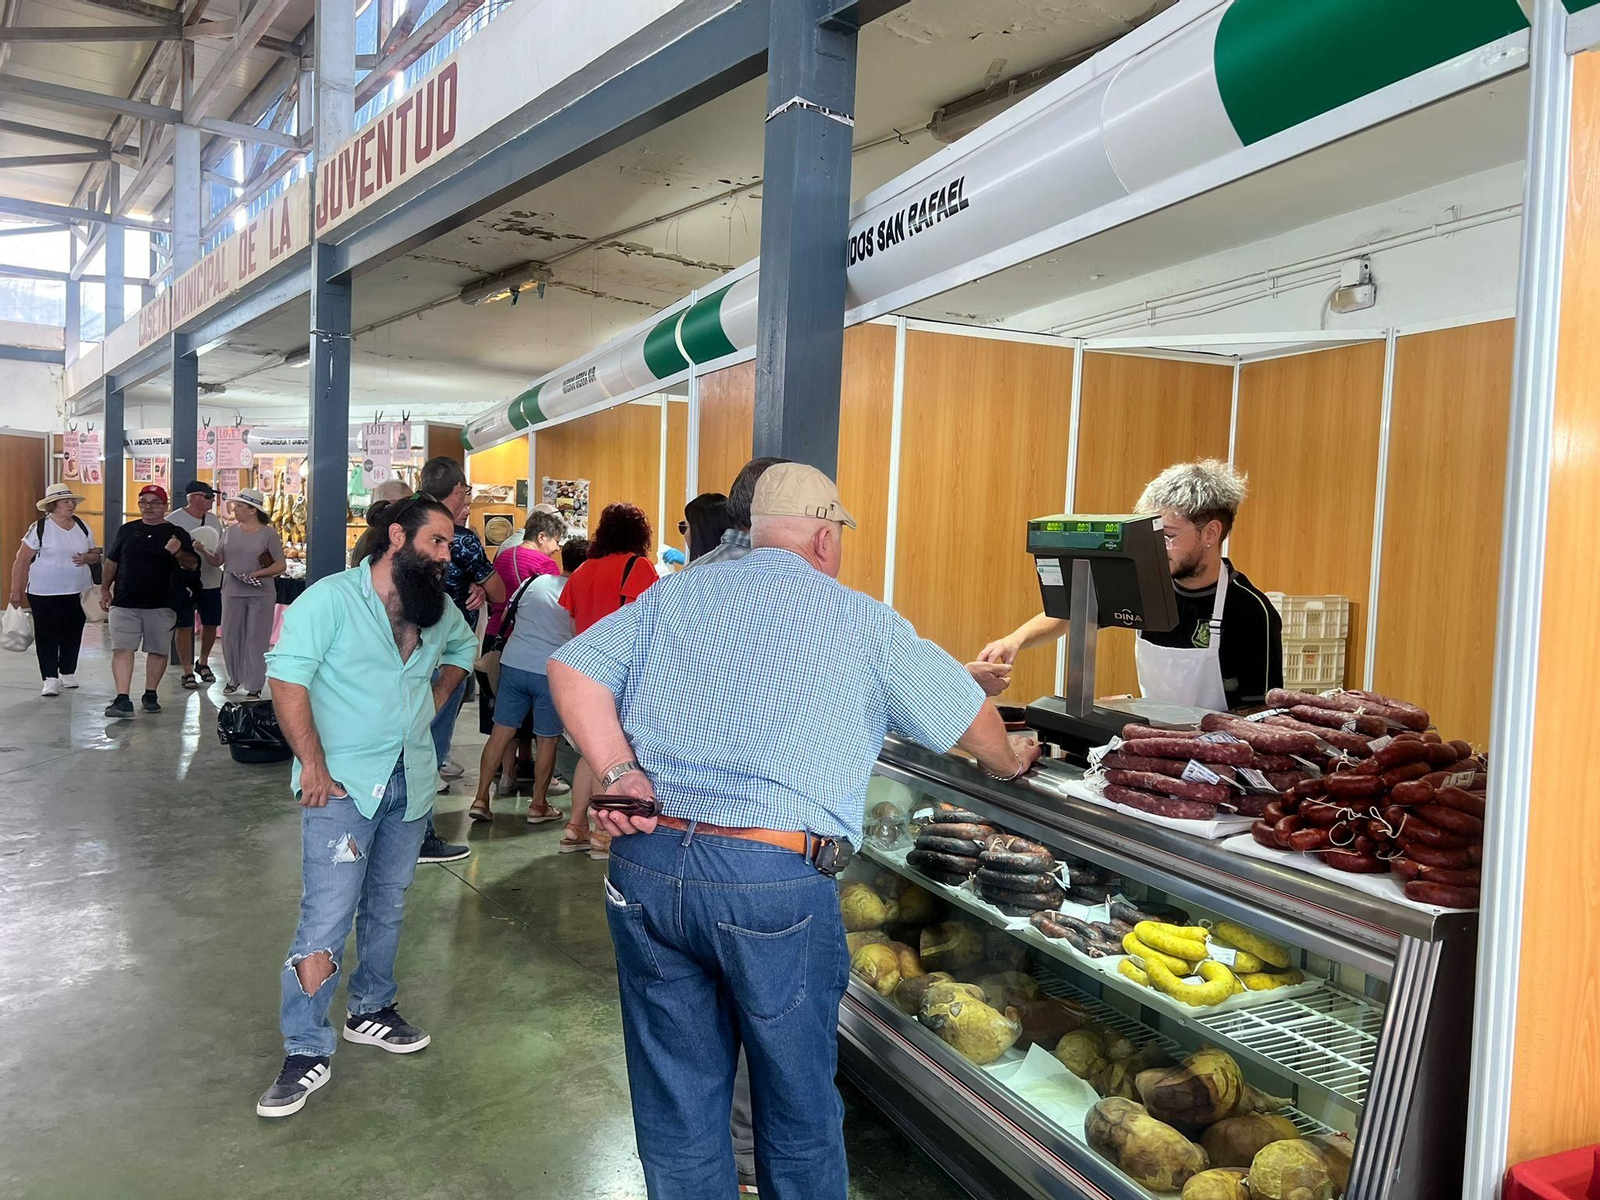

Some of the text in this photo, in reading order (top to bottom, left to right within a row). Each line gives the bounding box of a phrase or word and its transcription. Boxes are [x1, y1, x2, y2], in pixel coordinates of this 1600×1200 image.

[138, 61, 458, 348] CASETA MUNICIPAL DE LA JUVENTUD
[877, 208, 905, 251] SAN
[908, 175, 969, 237] RAFAEL
[219, 429, 237, 439] LOTE
[366, 423, 387, 435] LOTE
[363, 439, 369, 456] 4
[1113, 612, 1143, 622] DINA
